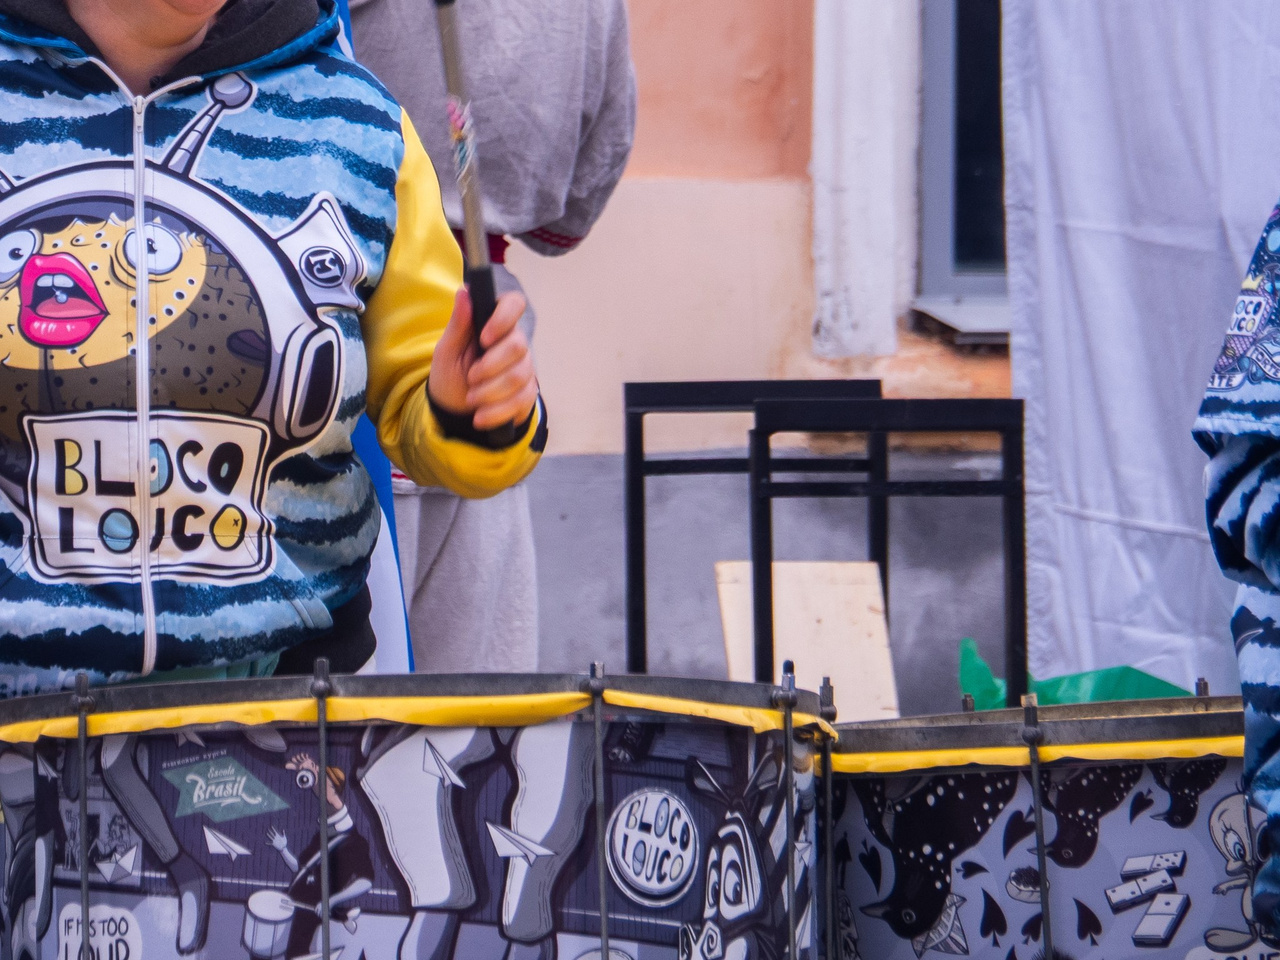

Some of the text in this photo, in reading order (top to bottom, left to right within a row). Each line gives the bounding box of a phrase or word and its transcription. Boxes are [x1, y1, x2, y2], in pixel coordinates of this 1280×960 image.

[1236, 300, 1262, 316] OCO
[54, 438, 244, 496] BLOCO
[186, 774, 262, 805] Brasil
[625, 797, 690, 851] BLOCO
[621, 833, 684, 884] LOUCO
[64, 918, 73, 936] IF
[98, 917, 129, 937] TOO
